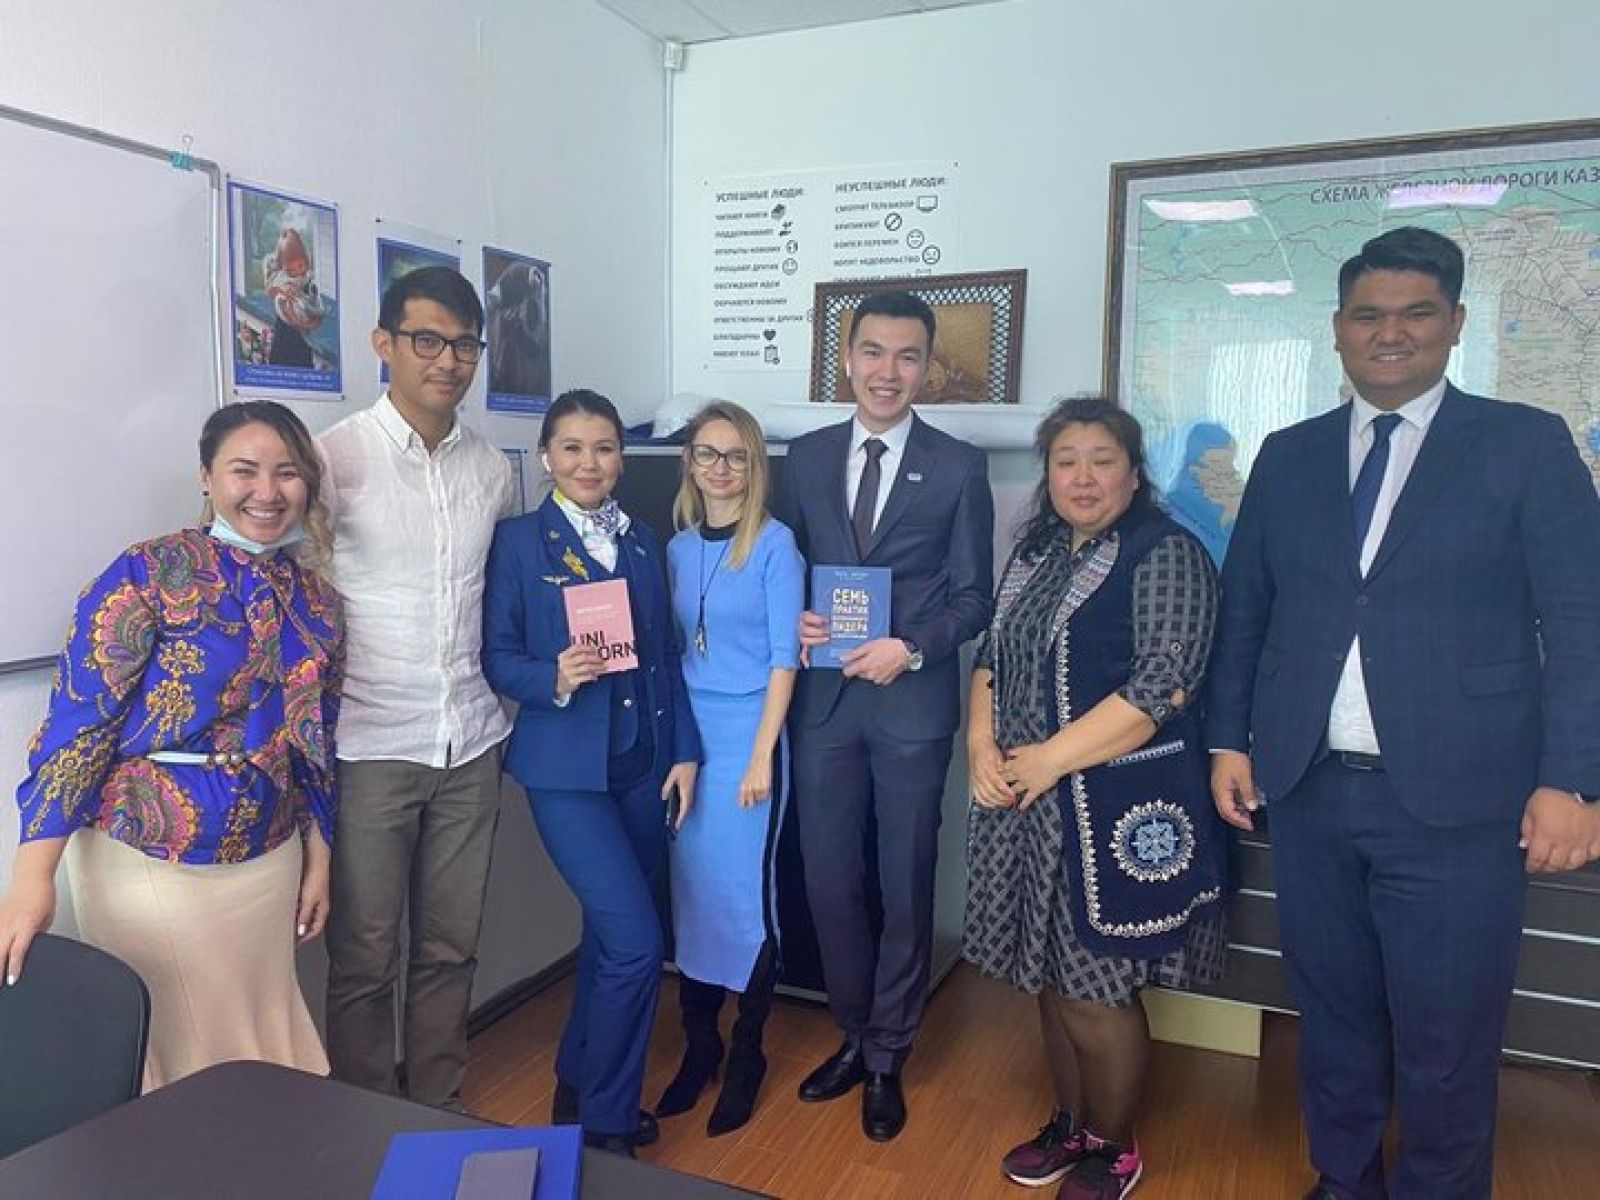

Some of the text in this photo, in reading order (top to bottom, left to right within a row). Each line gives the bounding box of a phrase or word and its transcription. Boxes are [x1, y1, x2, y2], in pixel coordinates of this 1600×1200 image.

[835, 180, 908, 193] НЕУСПЕШНЫЕ
[1310, 185, 1370, 204] СХЕМА
[1479, 169, 1559, 193] ДОРОГИ
[715, 190, 768, 202] УСПЕШНЫЕ
[832, 588, 870, 605] СЕМЬ
[597, 641, 636, 662] ORN
